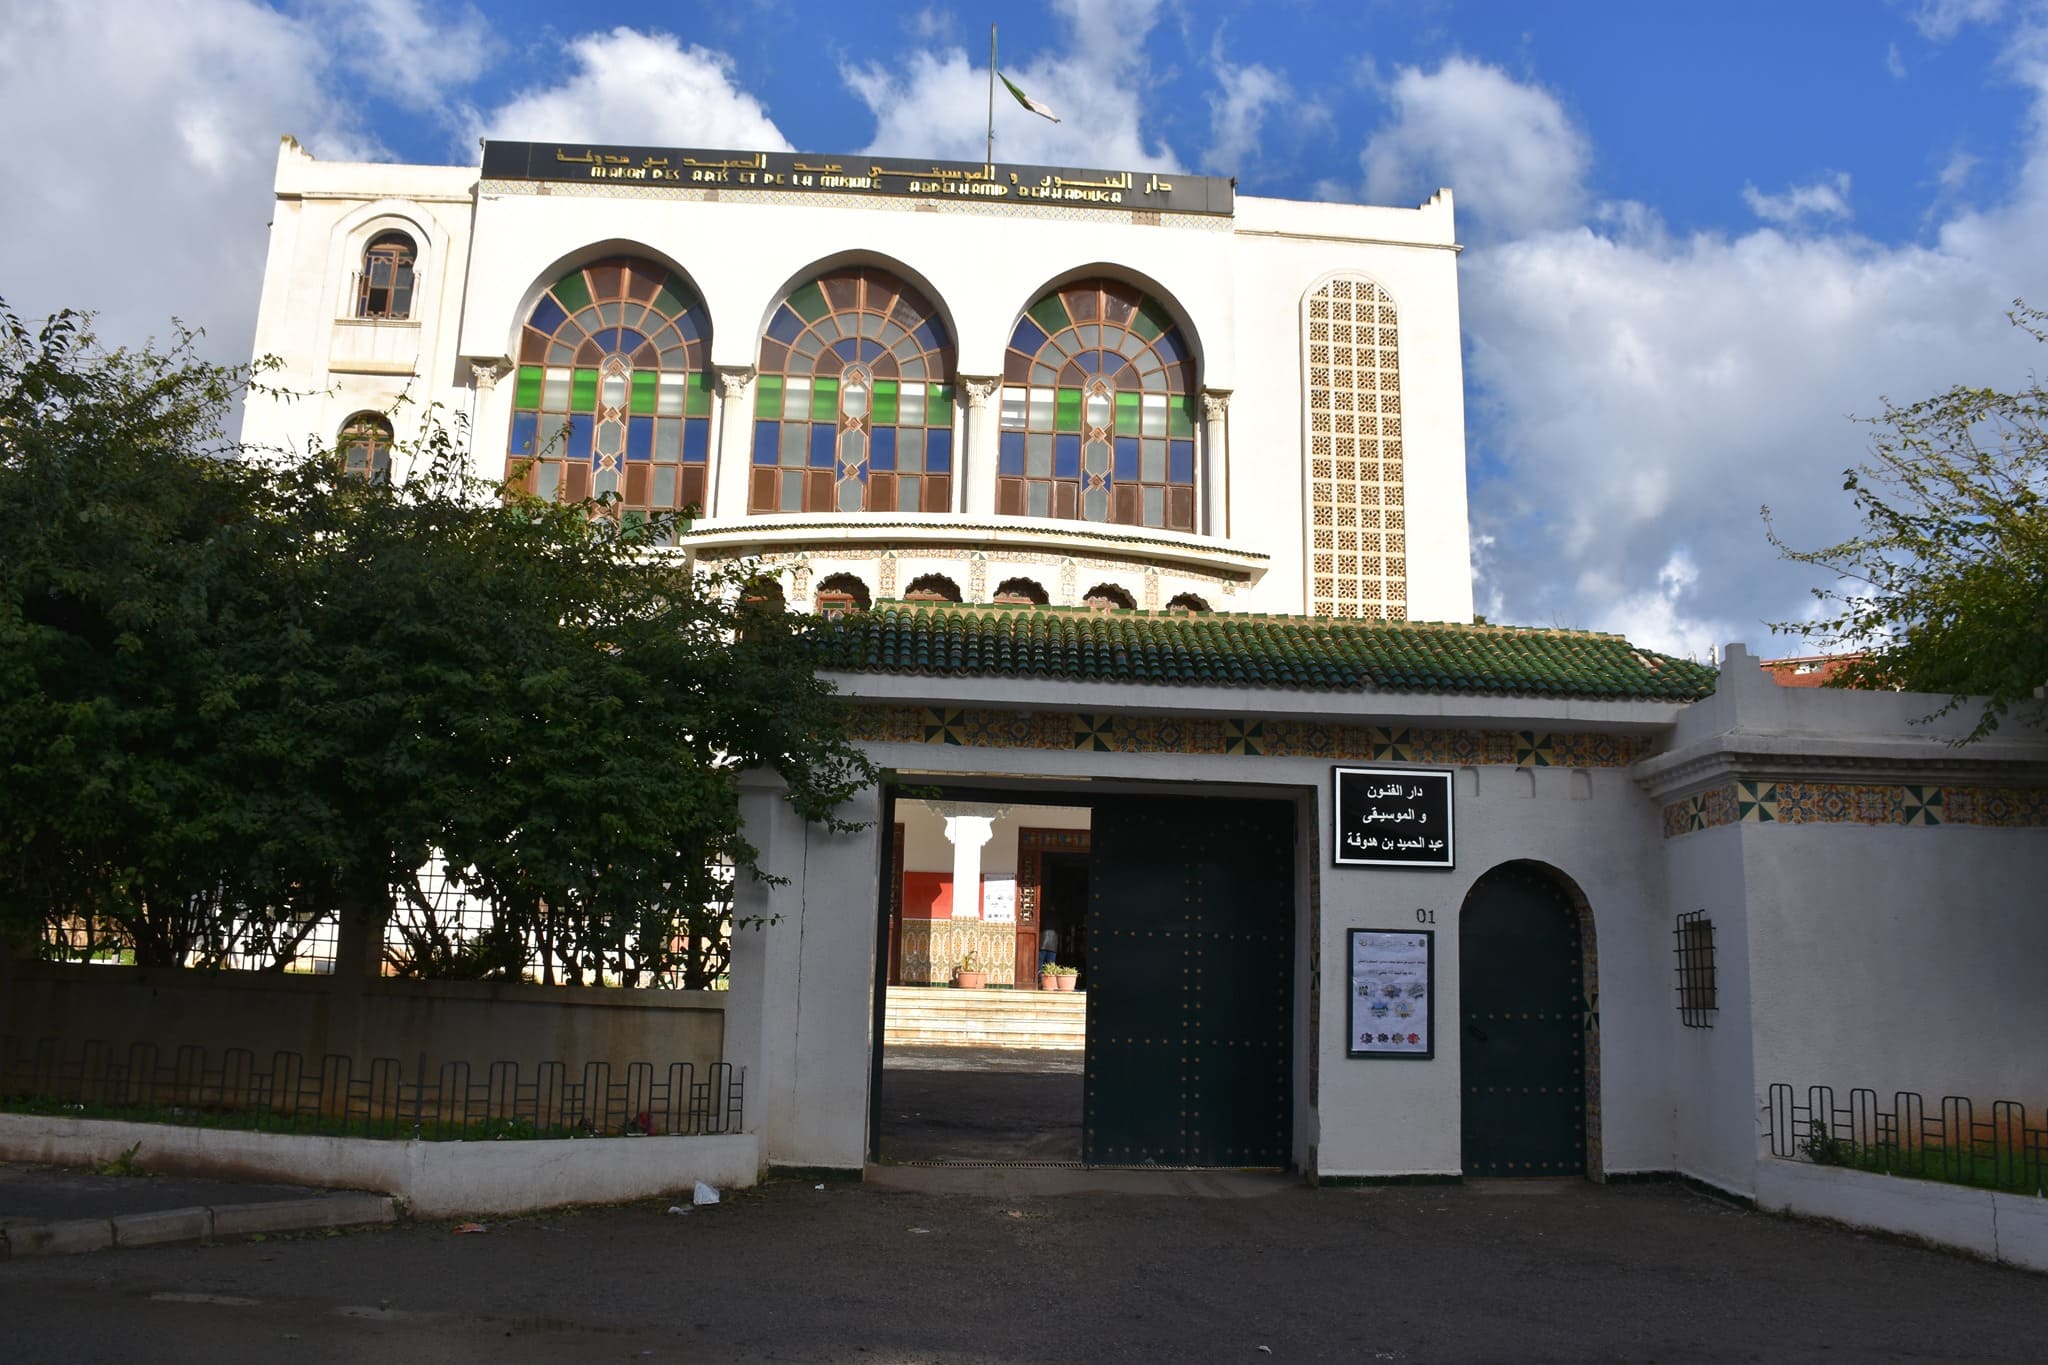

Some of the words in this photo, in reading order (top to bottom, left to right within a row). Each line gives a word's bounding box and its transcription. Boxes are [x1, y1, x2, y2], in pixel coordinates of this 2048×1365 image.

[642, 157, 668, 168] بن
[683, 153, 767, 171] الحميد
[793, 163, 842, 175] عبد
[590, 166, 645, 179] MAISON
[652, 169, 679, 180] DES
[691, 169, 729, 182] ARTS
[739, 172, 757, 184] ET
[763, 173, 785, 185] DE
[792, 174, 813, 187] LA
[820, 175, 881, 189] MUSIQUE
[909, 181, 1008, 196] ABDELHAMID
[1009, 172, 1018, 185] و
[1040, 172, 1132, 189] الفنون
[1145, 174, 1172, 194] دار
[1367, 784, 1403, 798] الفنون
[1407, 786, 1423, 799] دار
[1362, 807, 1415, 823] الموسيقى
[1419, 813, 1427, 823] و
[1347, 832, 1378, 849] هدوقة
[1381, 838, 1394, 850] بن
[1396, 837, 1425, 850] الحميد
[1428, 840, 1444, 851] عبد
[1416, 908, 1436, 924] 01
